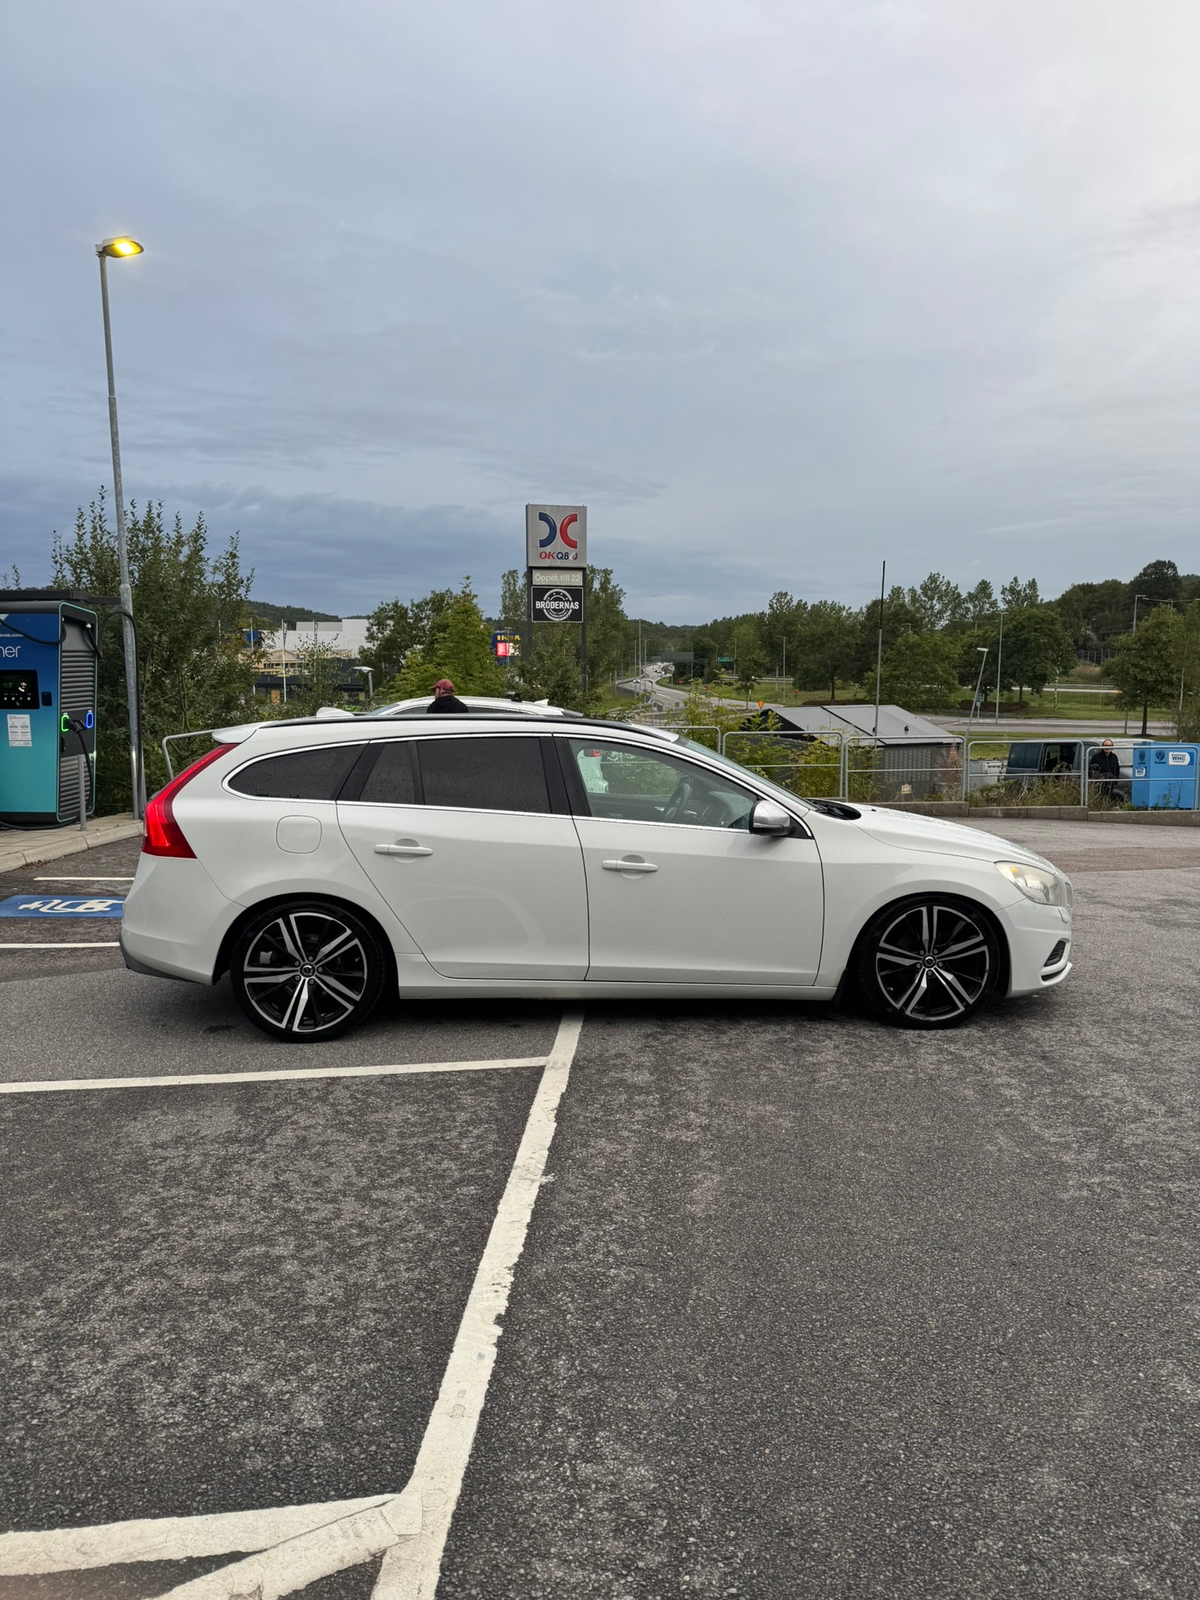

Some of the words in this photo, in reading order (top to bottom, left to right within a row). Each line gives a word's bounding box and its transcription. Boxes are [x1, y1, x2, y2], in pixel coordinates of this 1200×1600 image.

[539, 551, 569, 560] OKQ8
[560, 574, 570, 582] till
[571, 574, 581, 582] 22
[535, 599, 579, 610] BRÖDERNAS
